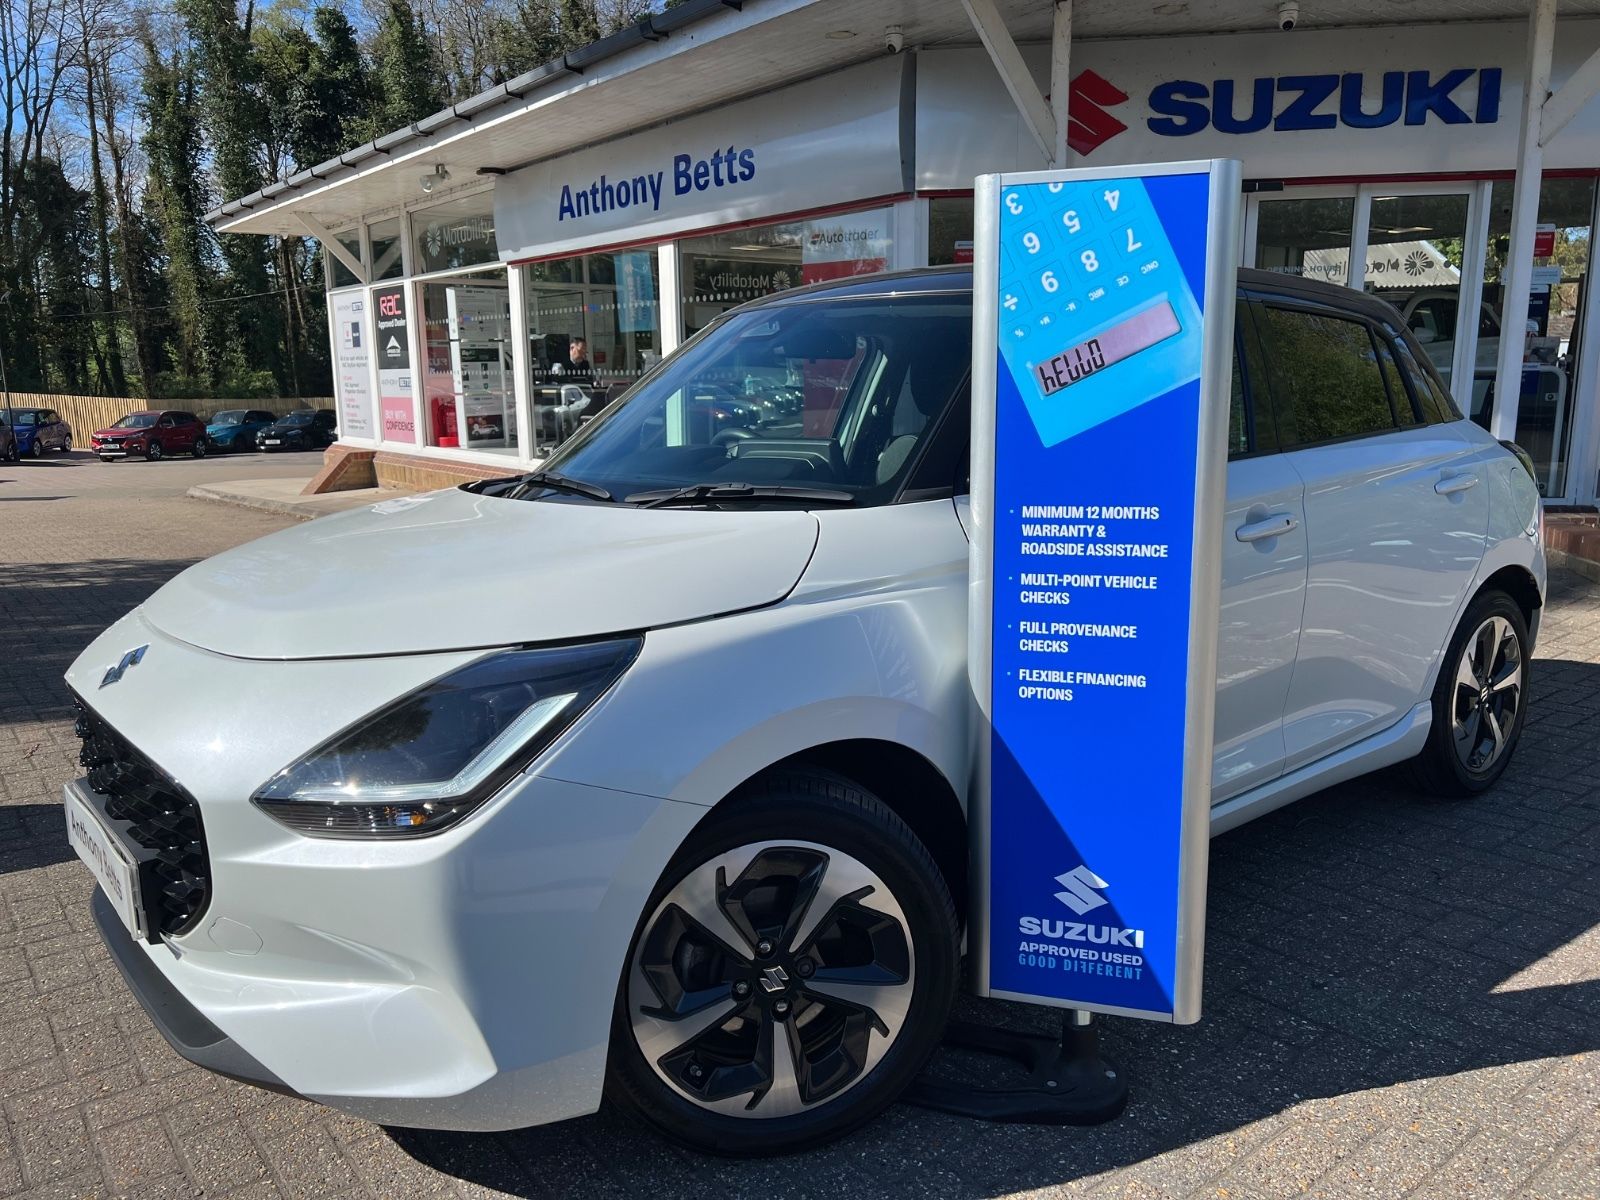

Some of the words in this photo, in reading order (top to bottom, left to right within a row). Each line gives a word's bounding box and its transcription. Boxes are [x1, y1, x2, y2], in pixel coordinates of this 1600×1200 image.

[1147, 67, 1502, 136] SUZUKI
[558, 171, 664, 221] Anthony
[673, 145, 756, 196] Betts
[1005, 192, 1024, 215] 3
[1104, 189, 1120, 212] 4
[1062, 210, 1081, 234] 5
[819, 228, 879, 244] Autotrader
[1126, 228, 1143, 252] 7
[1080, 250, 1099, 272] 8
[1022, 506, 1083, 518] MINIMUM
[1086, 506, 1099, 518] 12
[1101, 507, 1159, 519] MONTHS
[1022, 524, 1094, 537] WARRANTY
[1096, 525, 1106, 538] &
[1021, 543, 1084, 555] ROADSIDE
[1086, 544, 1168, 557] ASSISTANCE
[1020, 573, 1102, 587] MULTI-POINT
[1104, 576, 1157, 589] VEHICLE
[1020, 591, 1070, 604] CHECKS
[1020, 621, 1048, 634] FULL
[1051, 623, 1137, 638] PROVENANCE
[1019, 639, 1069, 653] CHECKS
[1019, 669, 1074, 683] FLEXIBLE
[1076, 672, 1147, 687] FINANCING
[1018, 686, 1073, 701] OPTIONS
[71, 809, 103, 873] Anthony
[1019, 916, 1144, 949] SUZUKI
[1019, 941, 1099, 961] APPROVED
[1101, 952, 1143, 966] USED
[1018, 953, 1056, 969] GOOD
[1063, 959, 1143, 980] DIFFERENT
